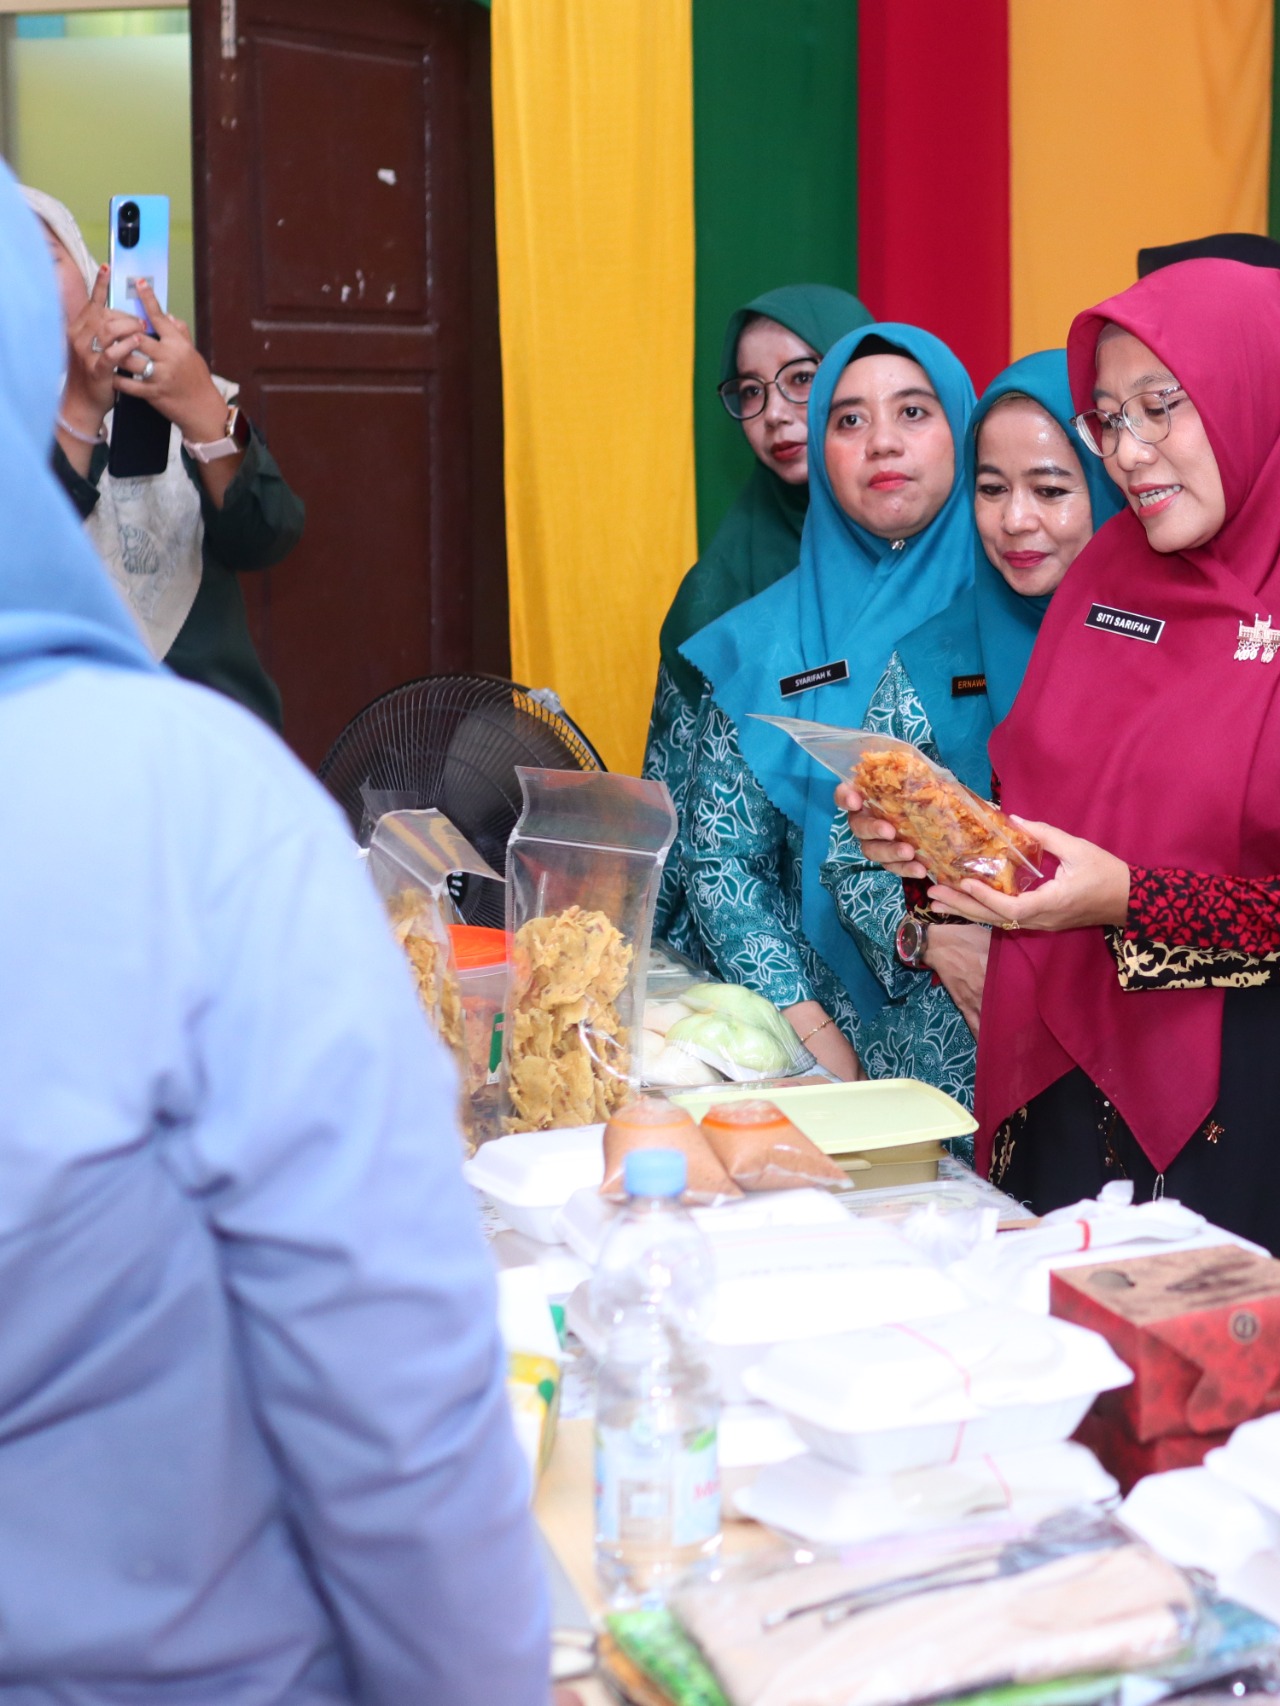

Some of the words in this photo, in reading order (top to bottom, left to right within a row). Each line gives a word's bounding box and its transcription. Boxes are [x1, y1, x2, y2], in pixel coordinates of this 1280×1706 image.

[1096, 612, 1114, 625] SITI
[1113, 617, 1151, 634] SARIFAH
[795, 671, 825, 687] SYARIFAH
[826, 669, 832, 678] K
